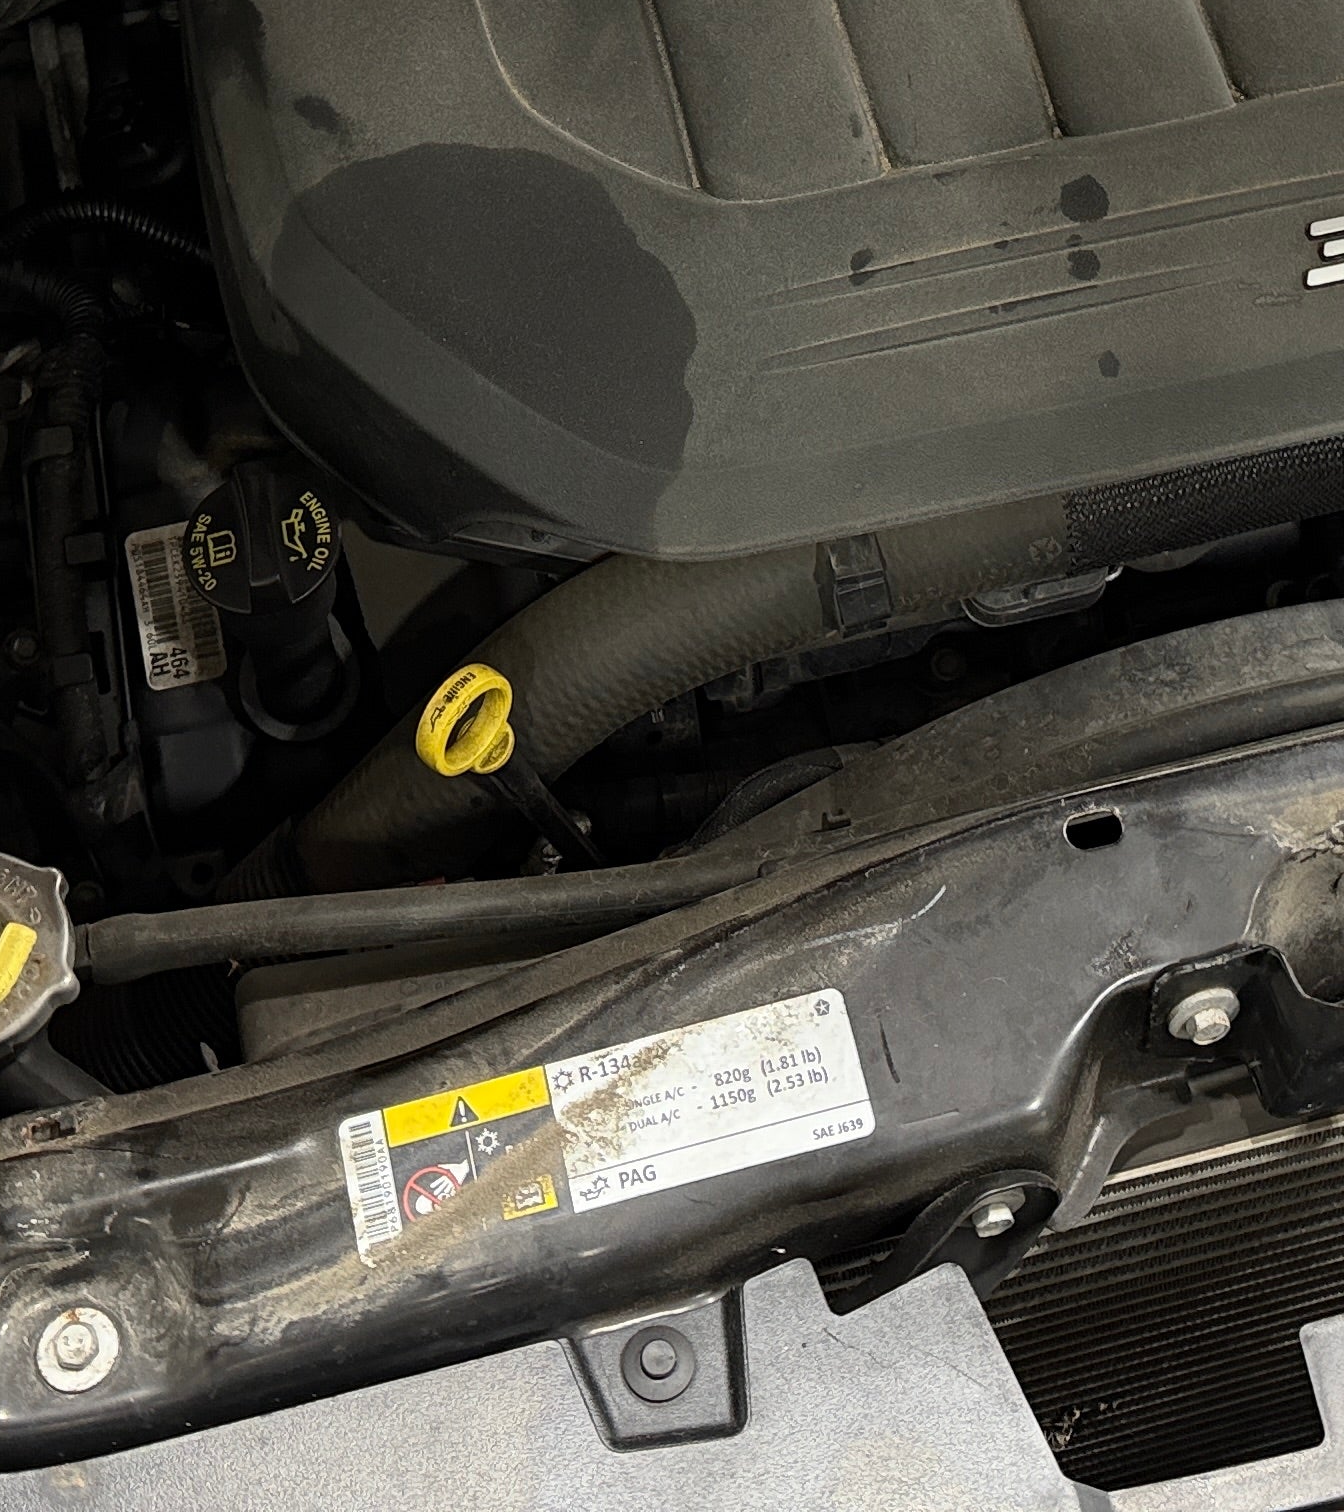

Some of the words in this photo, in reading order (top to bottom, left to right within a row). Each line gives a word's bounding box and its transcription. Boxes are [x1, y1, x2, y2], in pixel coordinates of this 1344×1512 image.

[191, 513, 212, 543] SAE
[298, 490, 332, 544] ENGINE
[189, 546, 218, 591] 5W-20
[306, 549, 331, 572] OIL
[150, 653, 171, 677] AH
[170, 647, 190, 679] 464
[444, 671, 477, 704] ENGINE
[664, 1086, 684, 1100] A/C
[714, 1068, 752, 1087] 820g
[760, 1054, 798, 1077] (1.81
[800, 1046, 822, 1064] lb)
[628, 1116, 658, 1133] DUAL
[660, 1109, 680, 1124] A/C
[711, 1088, 756, 1110] 1150g
[767, 1073, 805, 1097] (2.53
[807, 1066, 829, 1084] lb)
[812, 1125, 835, 1140] SAE
[838, 1118, 863, 1134] J639
[619, 1164, 657, 1189] PAG
